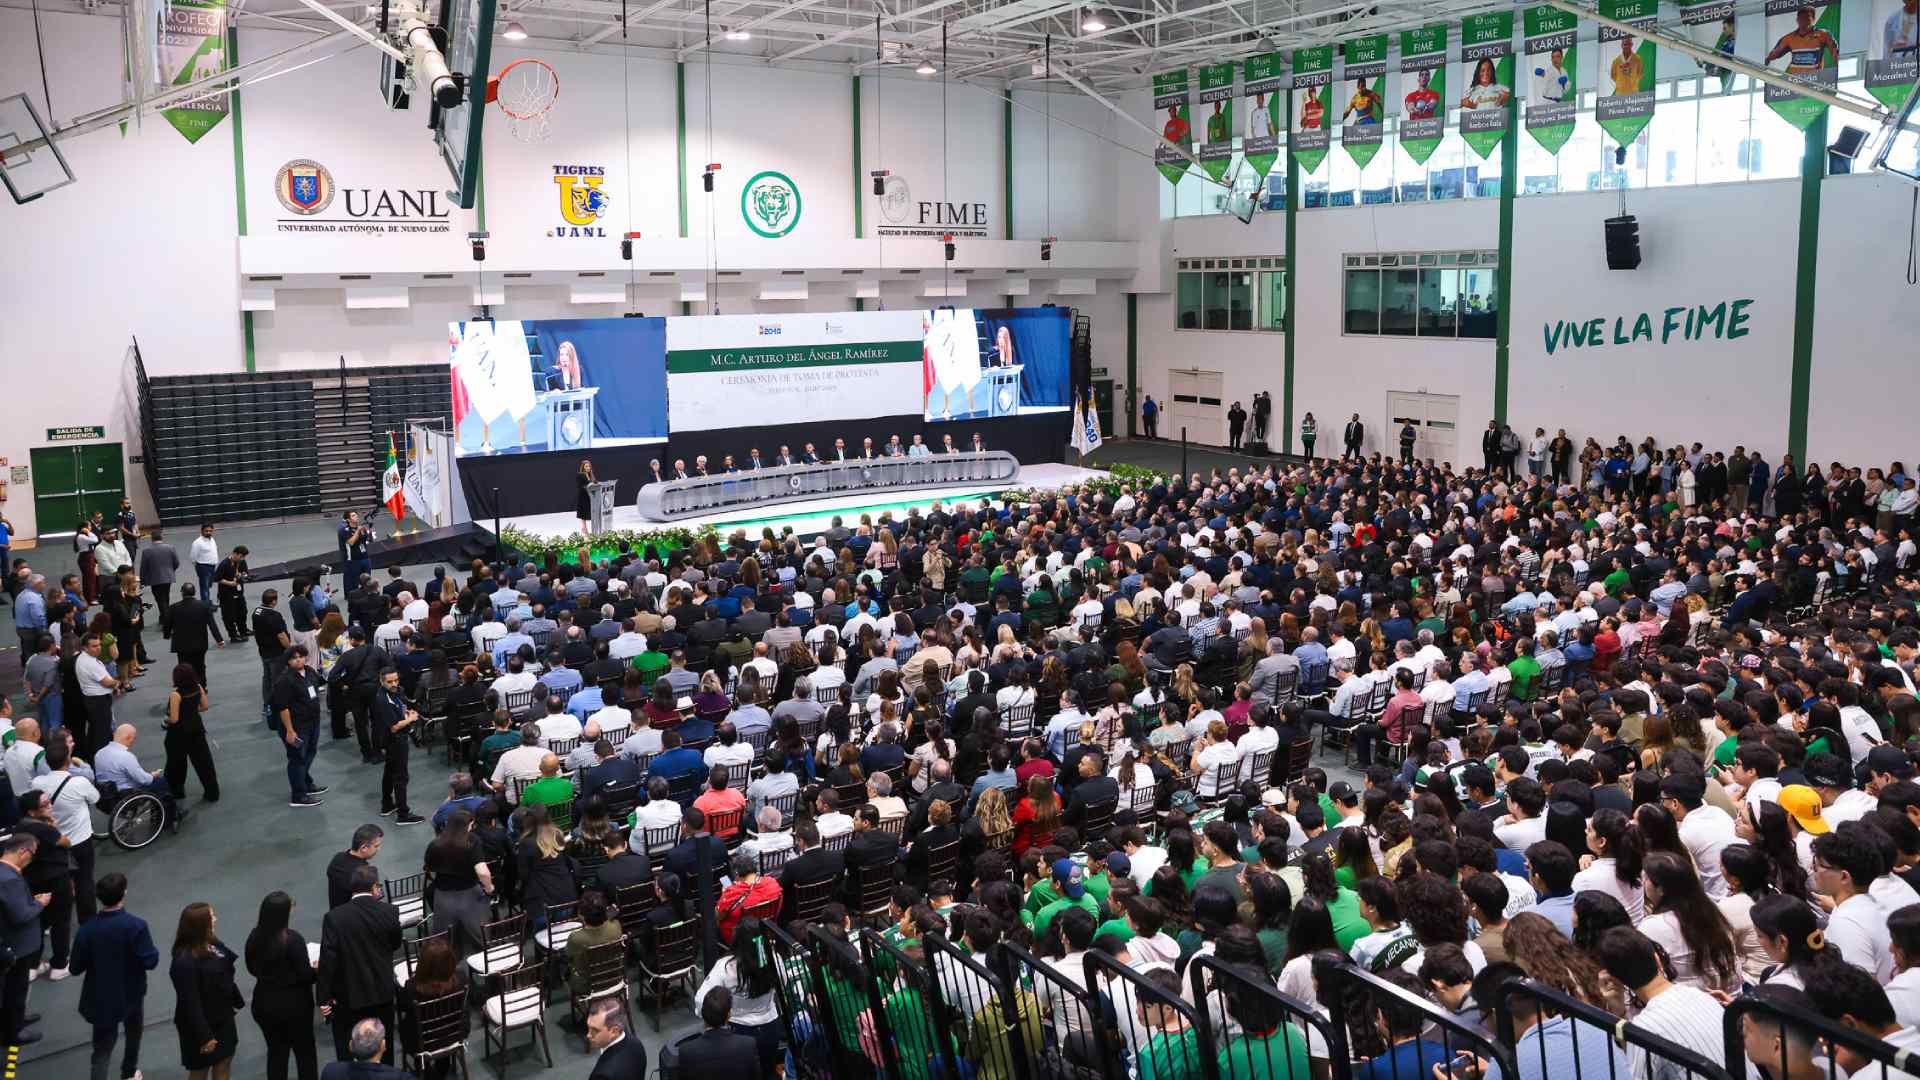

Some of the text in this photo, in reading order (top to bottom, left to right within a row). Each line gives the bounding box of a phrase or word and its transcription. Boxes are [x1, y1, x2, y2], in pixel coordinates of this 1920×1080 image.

[1616, 4, 1641, 17] FIME
[1539, 20, 1563, 32] FIME
[1476, 29, 1498, 39] FIME
[1413, 41, 1434, 53] FIME
[1532, 37, 1572, 52] KARATE
[1357, 50, 1375, 61] FIME
[1467, 47, 1504, 59] SOFTBOL
[1295, 74, 1330, 88] SOFTBOL
[552, 165, 605, 176] TIGRES
[342, 189, 450, 218] UANL
[917, 201, 987, 225] FIME
[277, 224, 337, 232] UNIVERSIDAD
[338, 224, 385, 233] AUTÓNOMA
[401, 225, 428, 233] NUEVO
[429, 225, 450, 233] LEÓN
[556, 226, 607, 238] UANL
[1543, 298, 1755, 356] VIVE LA FIME
[711, 347, 889, 366] M.C. ARTURO DEL ÁNGEL RAMÍREZ
[51, 432, 100, 440] EMERGENCIA
